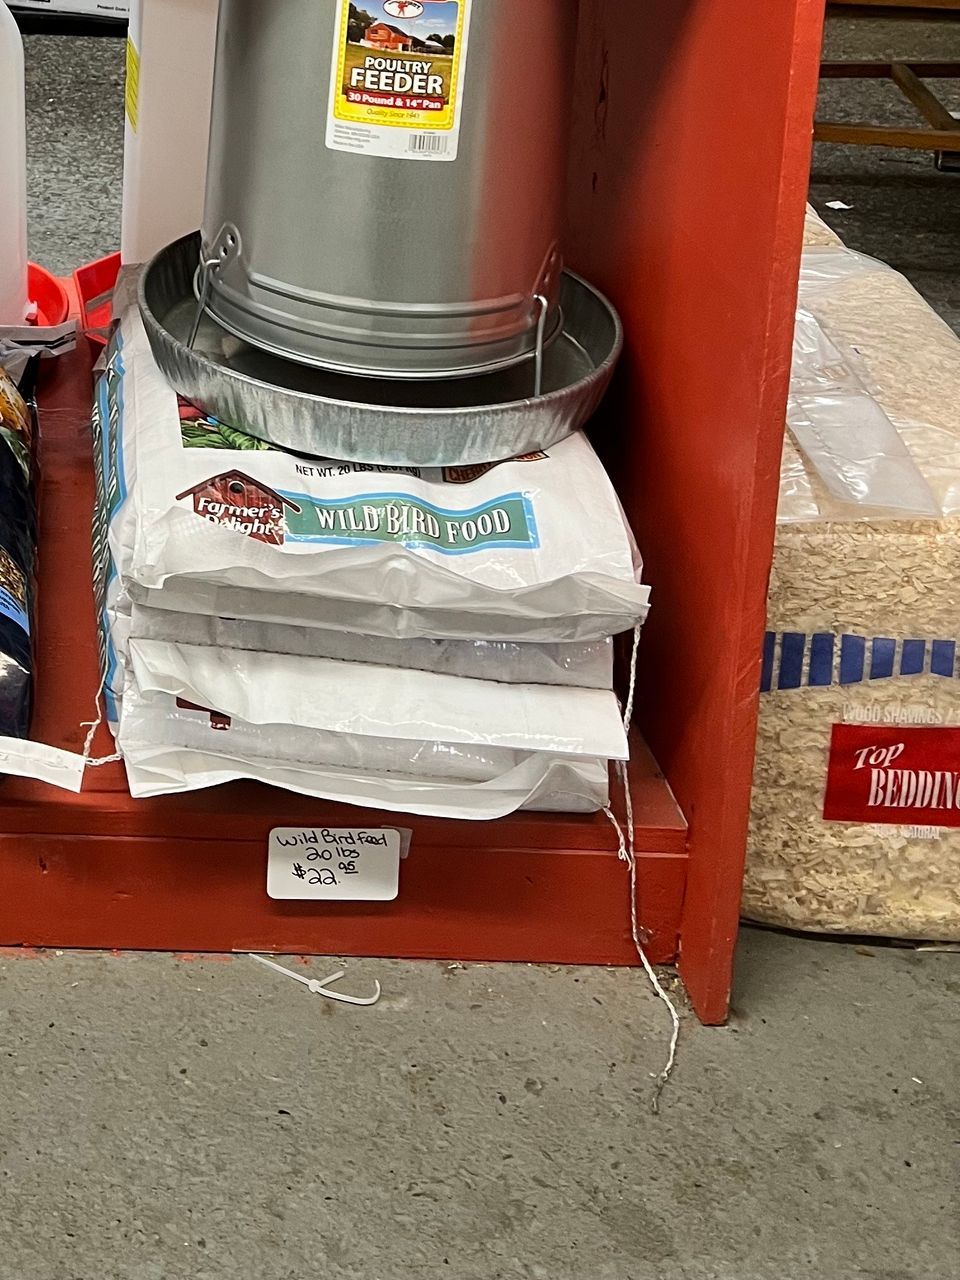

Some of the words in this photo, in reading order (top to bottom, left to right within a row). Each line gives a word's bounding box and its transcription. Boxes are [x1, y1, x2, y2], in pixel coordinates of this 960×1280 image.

[365, 56, 431, 74] POULTRY
[350, 67, 443, 94] FEEDER
[348, 91, 360, 101] 30
[362, 93, 394, 106] Pound
[395, 97, 405, 106] &
[423, 100, 440, 109] Pan
[295, 463, 315, 477] NET
[316, 466, 337, 478] WT.
[337, 464, 351, 475] 20
[198, 497, 282, 519] Farmer's
[314, 505, 379, 531] WILD
[384, 506, 440, 539] BIRD
[446, 507, 511, 544] FOOD
[843, 704, 881, 721] WOOD
[277, 830, 318, 847] Wild
[321, 829, 356, 845] Bird
[357, 831, 388, 847] Feed
[306, 847, 332, 861] 20
[336, 847, 360, 859] lbs
